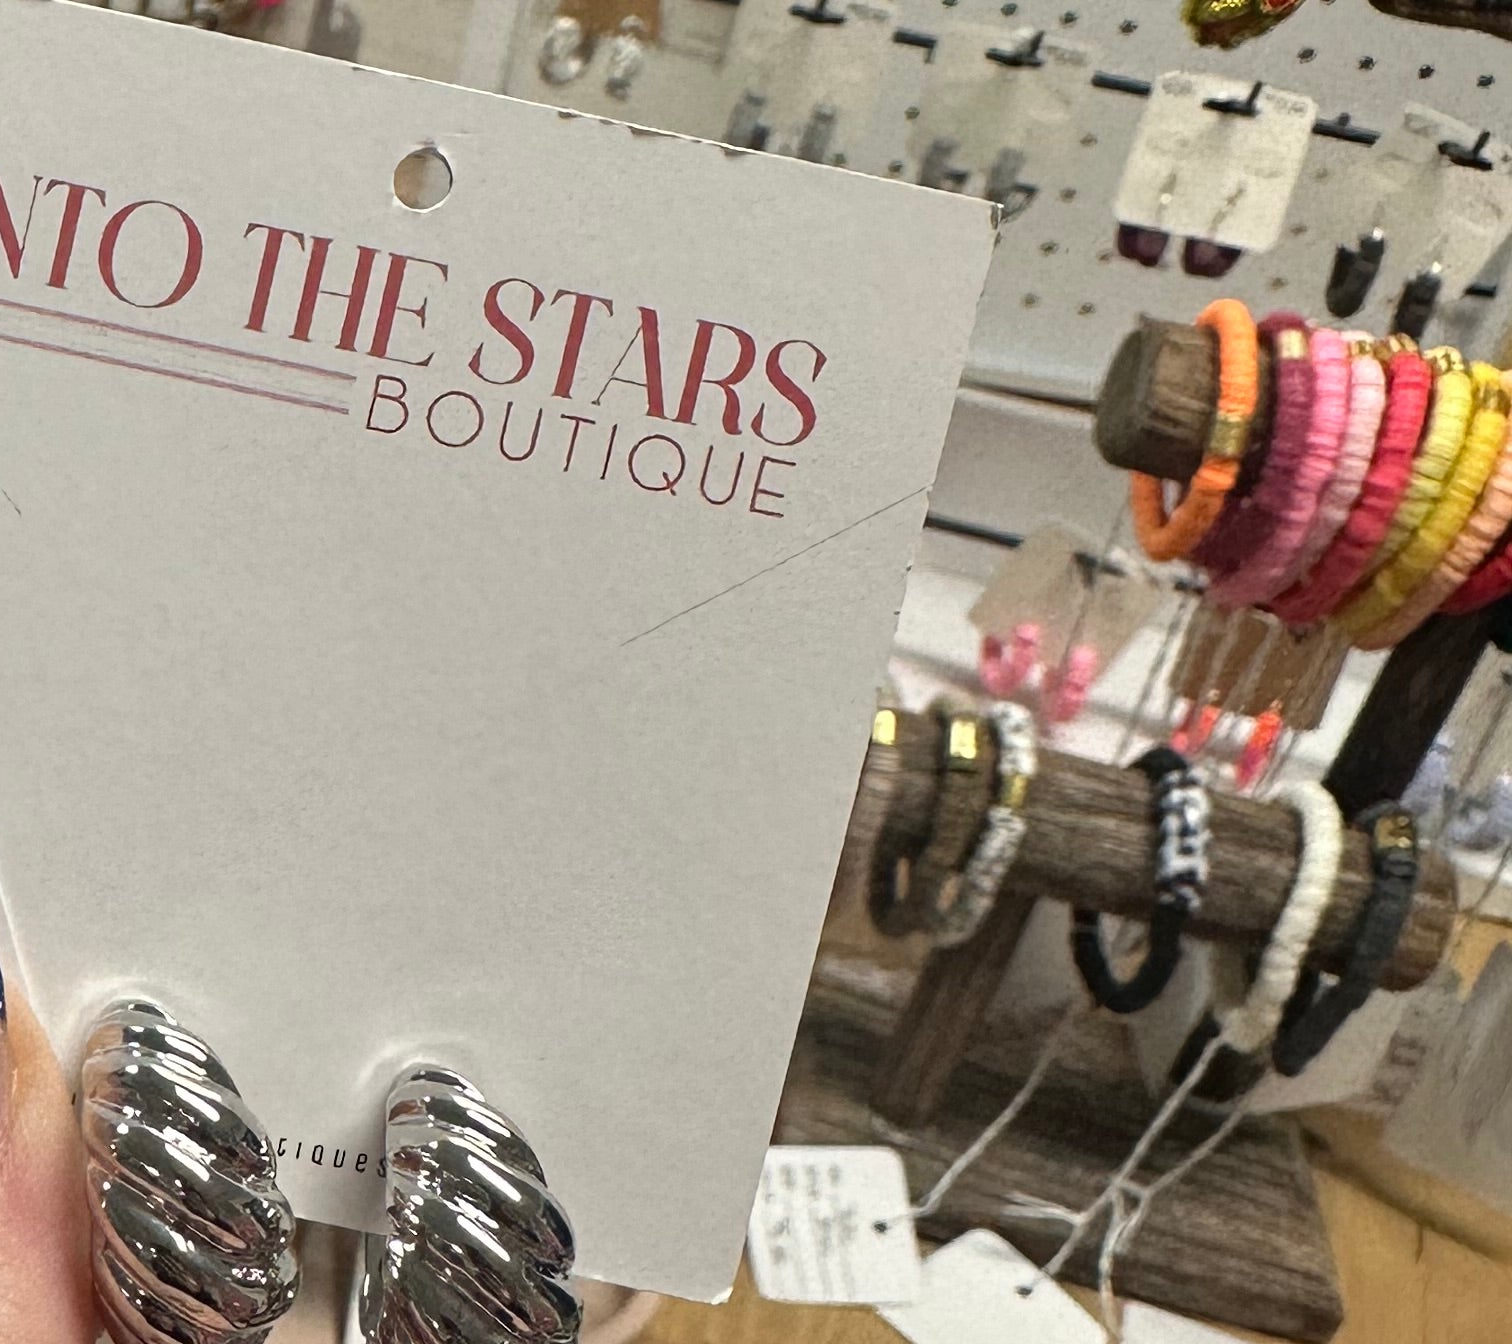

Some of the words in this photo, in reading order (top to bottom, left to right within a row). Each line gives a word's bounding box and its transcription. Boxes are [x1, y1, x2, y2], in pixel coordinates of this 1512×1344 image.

[243, 222, 449, 367] THE
[468, 278, 828, 445] STARS
[365, 375, 796, 518] BOUTIQUE
